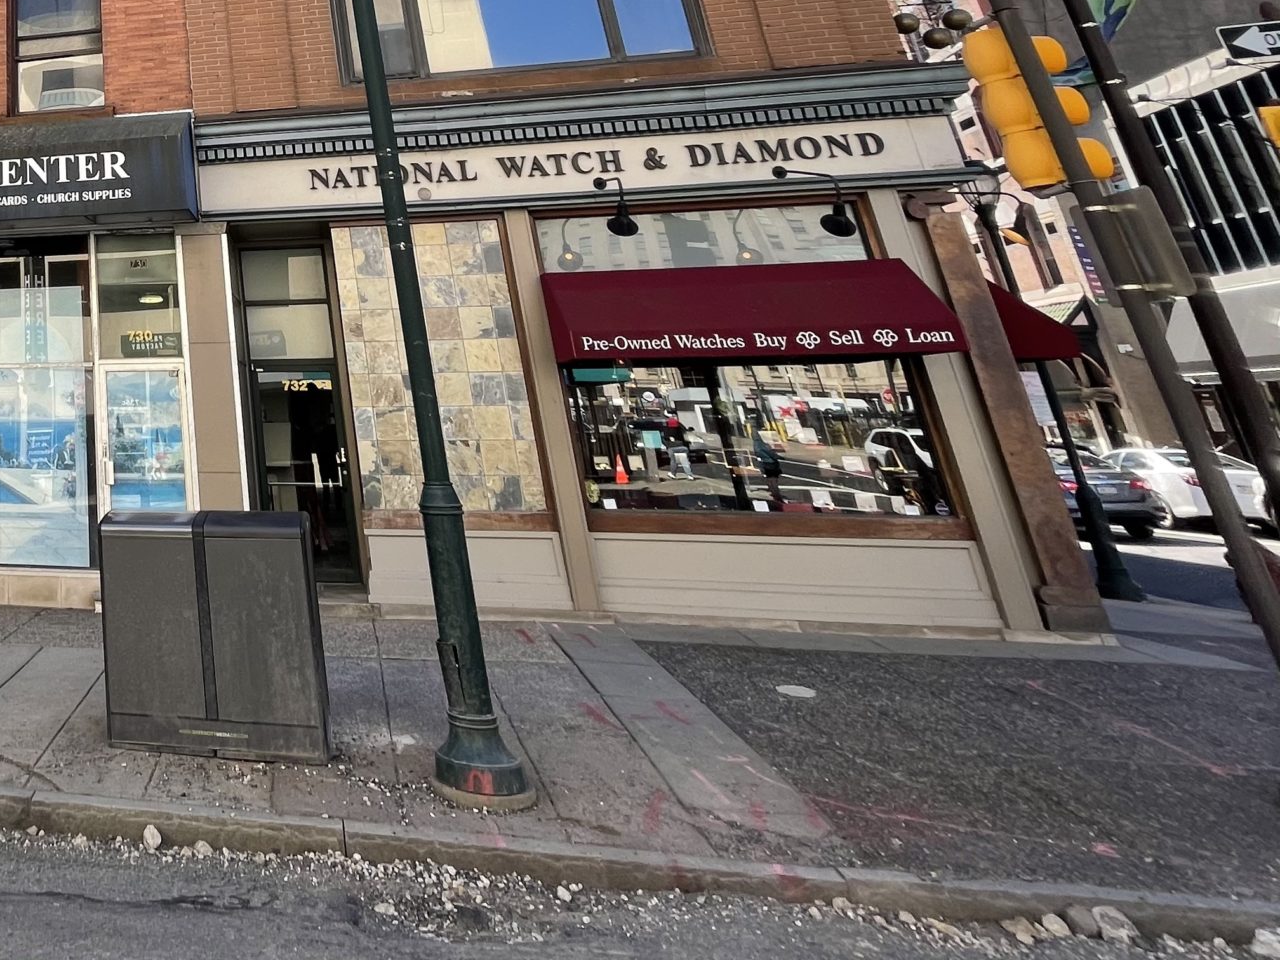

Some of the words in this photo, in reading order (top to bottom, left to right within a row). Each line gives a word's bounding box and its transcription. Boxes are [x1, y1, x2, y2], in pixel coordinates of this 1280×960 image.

[495, 150, 625, 179] WATCH
[643, 146, 668, 171] &
[684, 132, 885, 168] DIAMOND
[36, 191, 79, 204] CHURCH
[82, 188, 132, 201] SUPPLIES
[127, 330, 153, 342] 730
[581, 334, 671, 351] Pre-Owned
[674, 334, 745, 350] Watches
[753, 332, 787, 351] Buy
[828, 329, 864, 346] Sell
[904, 327, 955, 344] Loan
[281, 379, 309, 392] 732
